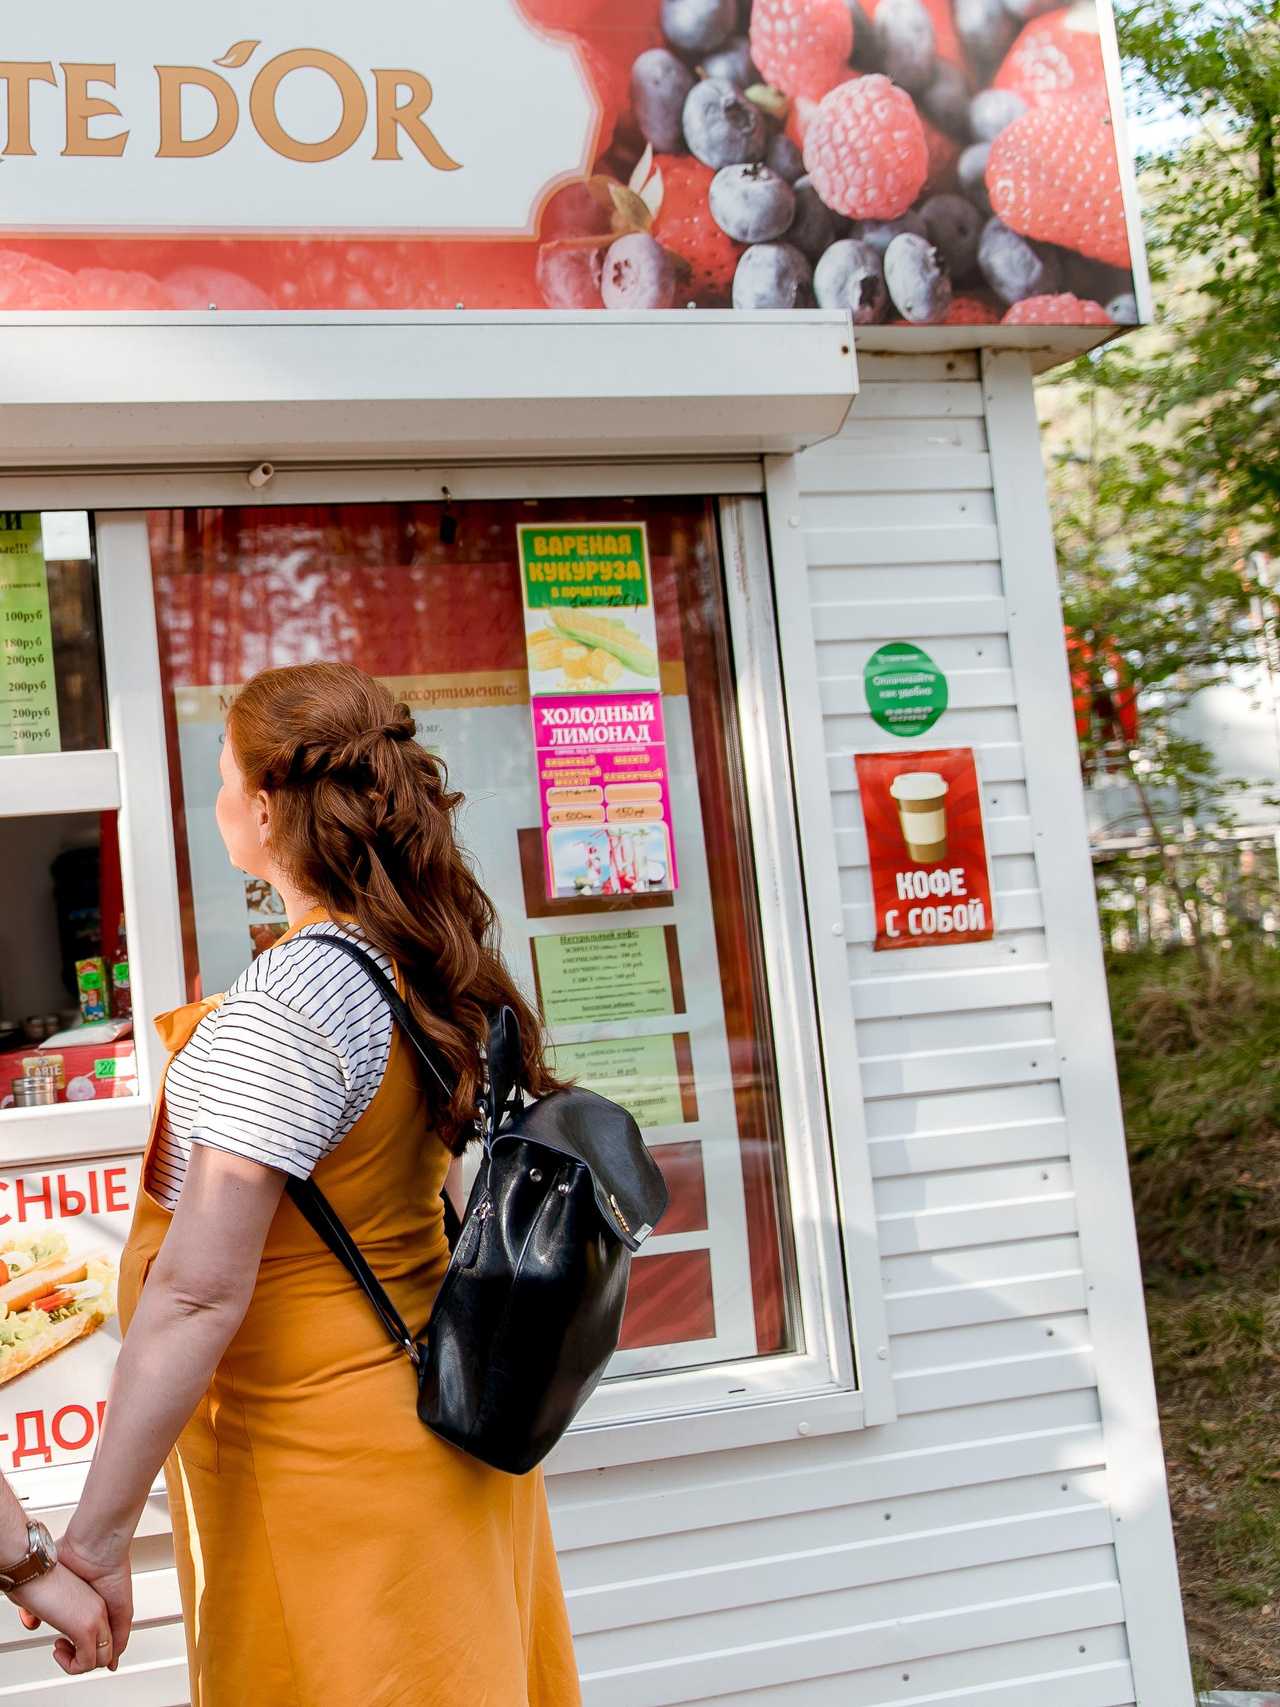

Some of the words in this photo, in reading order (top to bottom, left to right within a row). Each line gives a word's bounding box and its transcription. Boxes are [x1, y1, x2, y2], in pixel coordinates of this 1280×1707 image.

[154, 40, 464, 171] D'OR
[533, 534, 632, 557] ВАРЕНАЯ
[528, 560, 641, 582] КУКУРУЗА
[5, 610, 43, 623] 100руб
[5, 637, 42, 650] 180руб
[6, 654, 45, 667] 200руб
[8, 680, 47, 694] 200руб
[400, 683, 519, 705] ассортименте:
[12, 707, 51, 720] 200руб
[541, 701, 655, 726] ХОЛОДНЫЙ
[12, 728, 51, 741] 200руб
[549, 724, 651, 746] ЛИМОНАД
[896, 867, 967, 901] КОФЕ
[885, 909, 900, 938] С
[908, 898, 986, 936] СОБОЙ
